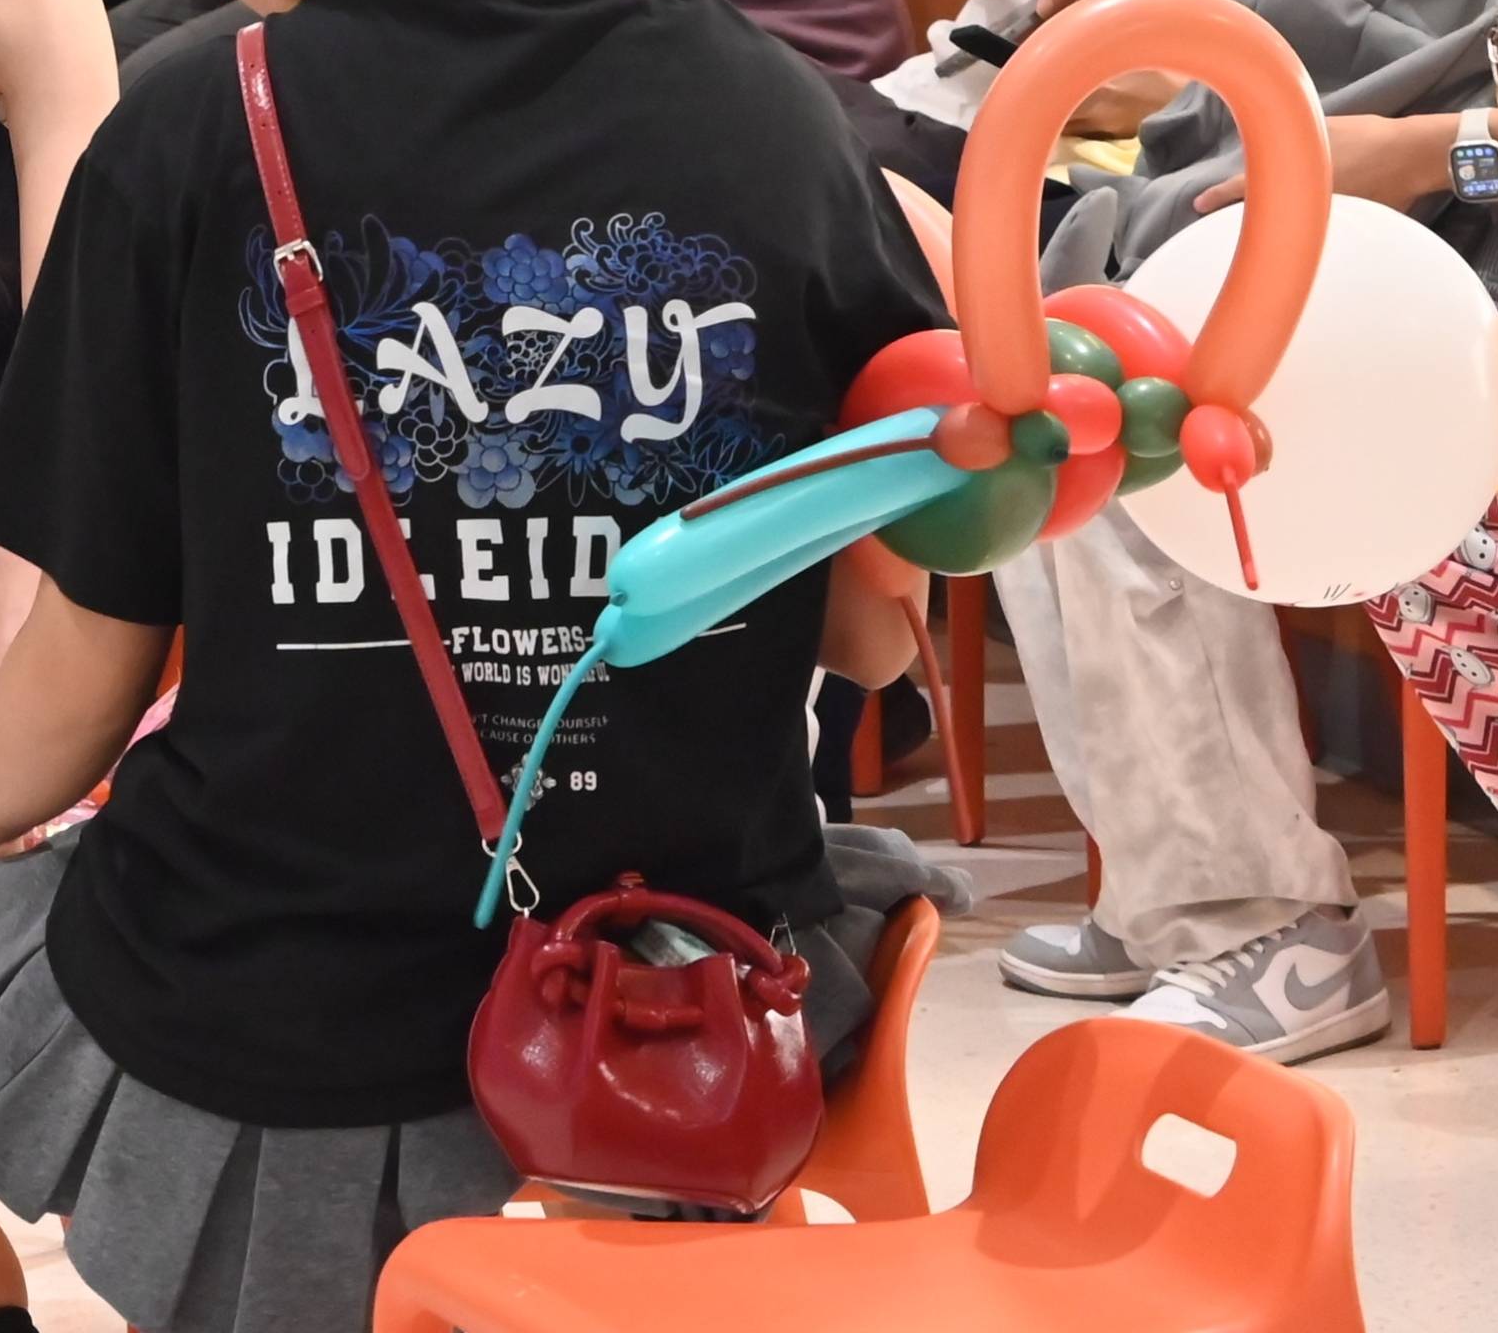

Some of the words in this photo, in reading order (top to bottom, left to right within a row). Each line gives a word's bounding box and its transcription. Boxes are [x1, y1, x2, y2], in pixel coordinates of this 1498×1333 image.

[266, 515, 622, 605] IDEID
[451, 626, 586, 656] FLOWERS
[462, 661, 512, 684] WORLD
[516, 664, 532, 686] IS
[557, 714, 610, 730] OURSELF
[551, 733, 597, 746] THERS
[569, 770, 598, 792] 89
